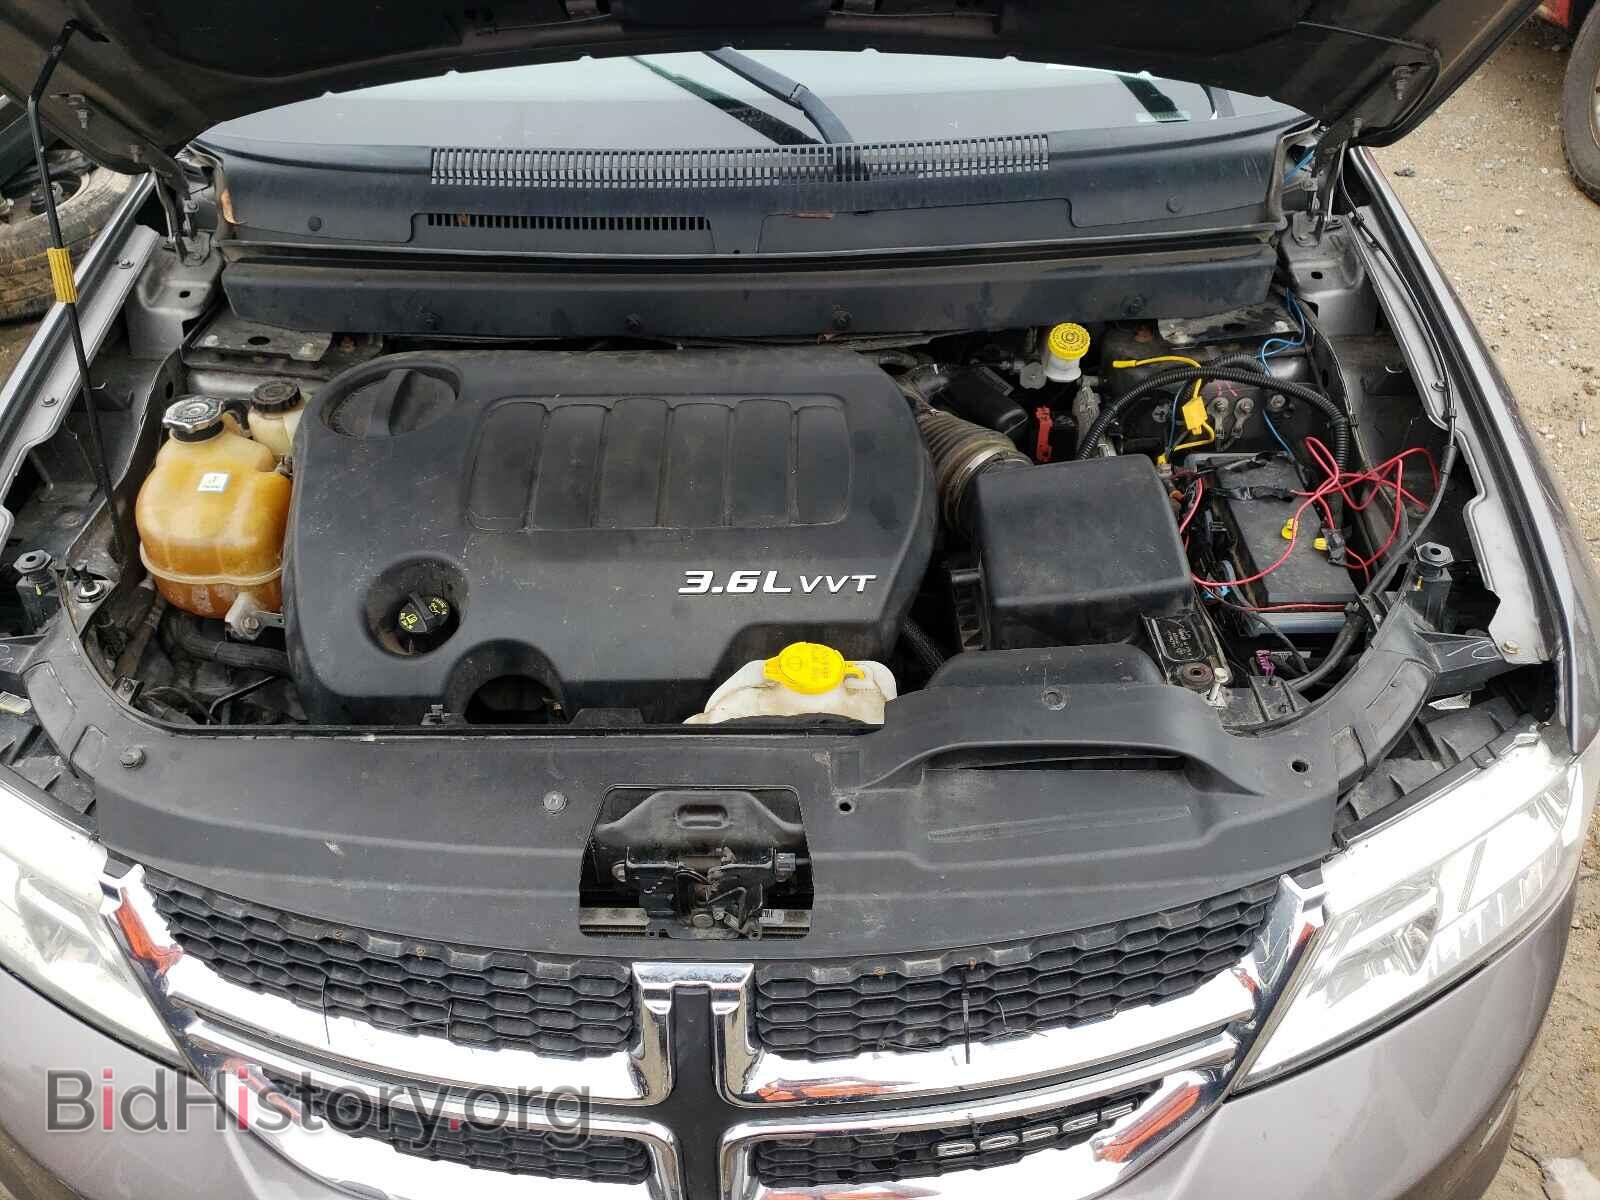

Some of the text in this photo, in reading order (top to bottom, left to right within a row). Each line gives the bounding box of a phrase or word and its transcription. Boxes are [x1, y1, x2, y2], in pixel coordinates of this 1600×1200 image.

[678, 570, 877, 595] 3.6L VVT
[935, 1101, 1135, 1158] DODGE
